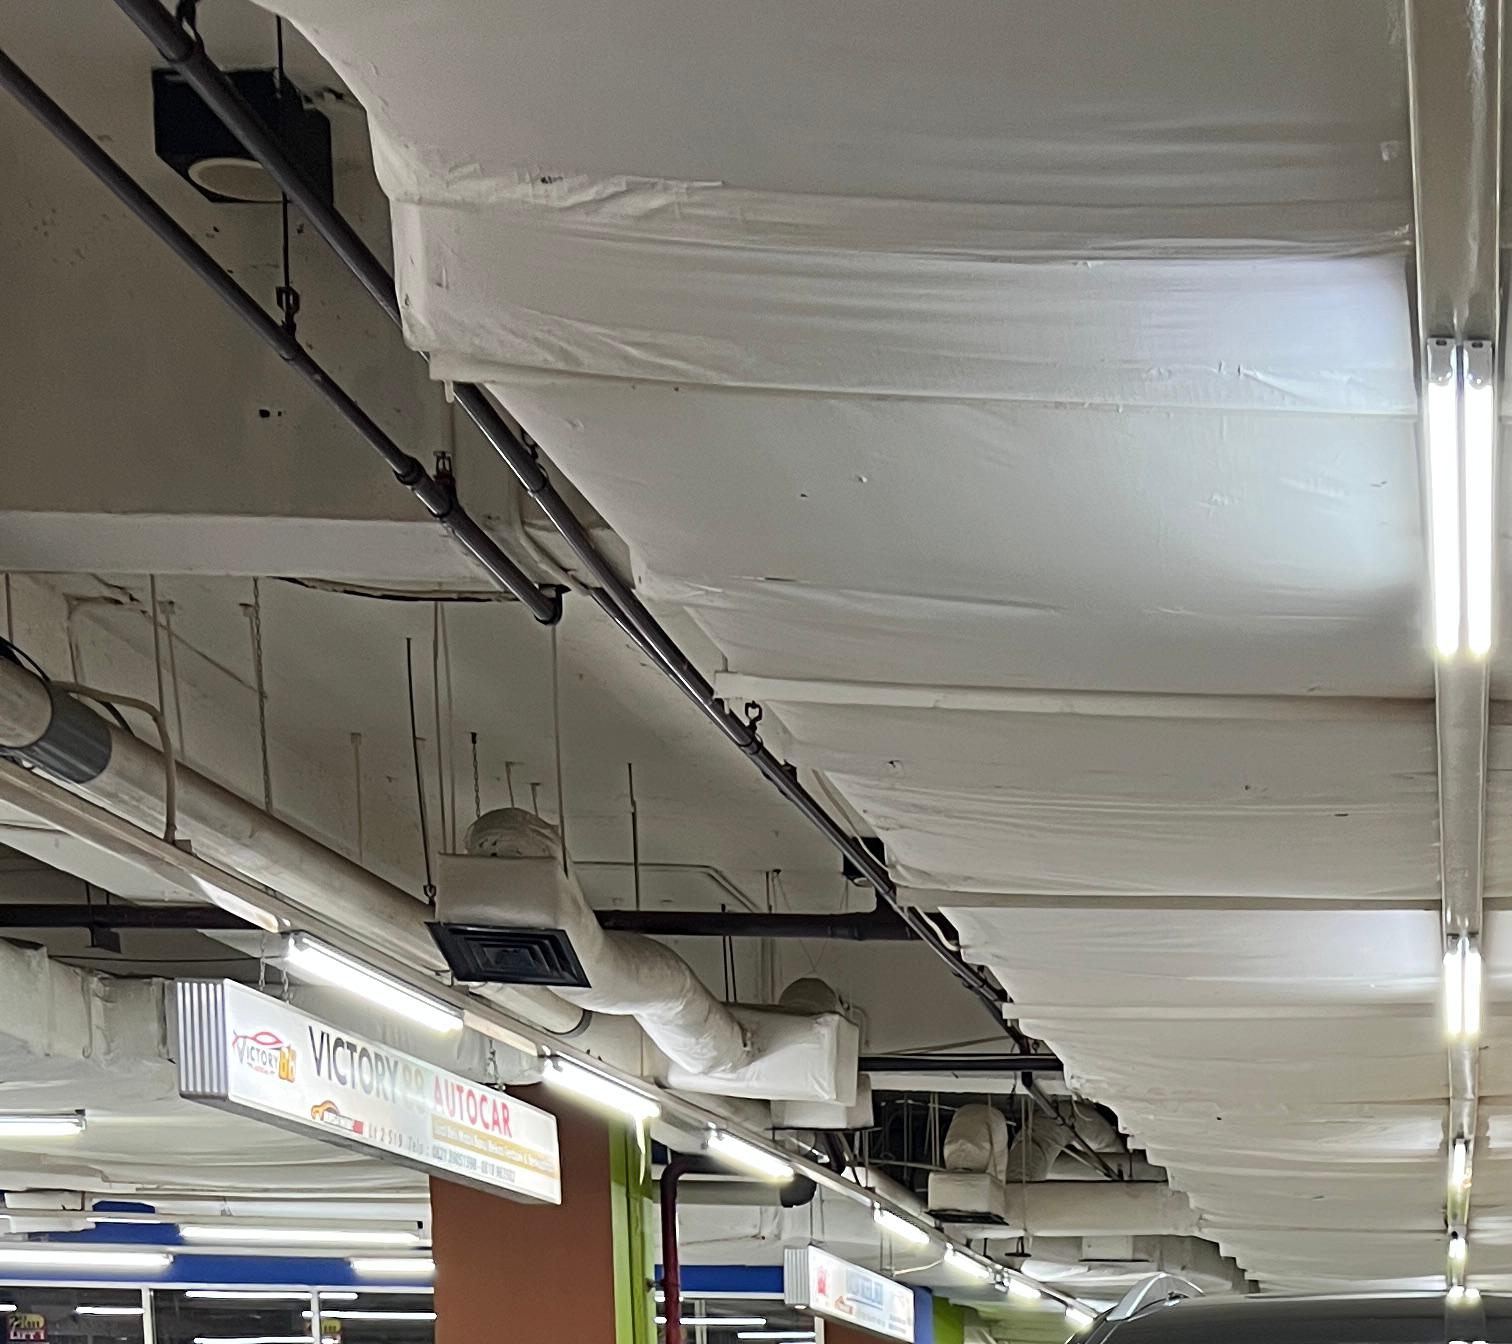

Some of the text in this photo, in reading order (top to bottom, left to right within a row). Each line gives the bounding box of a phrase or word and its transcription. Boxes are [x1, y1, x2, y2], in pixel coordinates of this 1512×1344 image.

[237, 1038, 278, 1069] VICTORY
[308, 1025, 399, 1104] VICTORY
[433, 1074, 513, 1138] AUTOCAR
